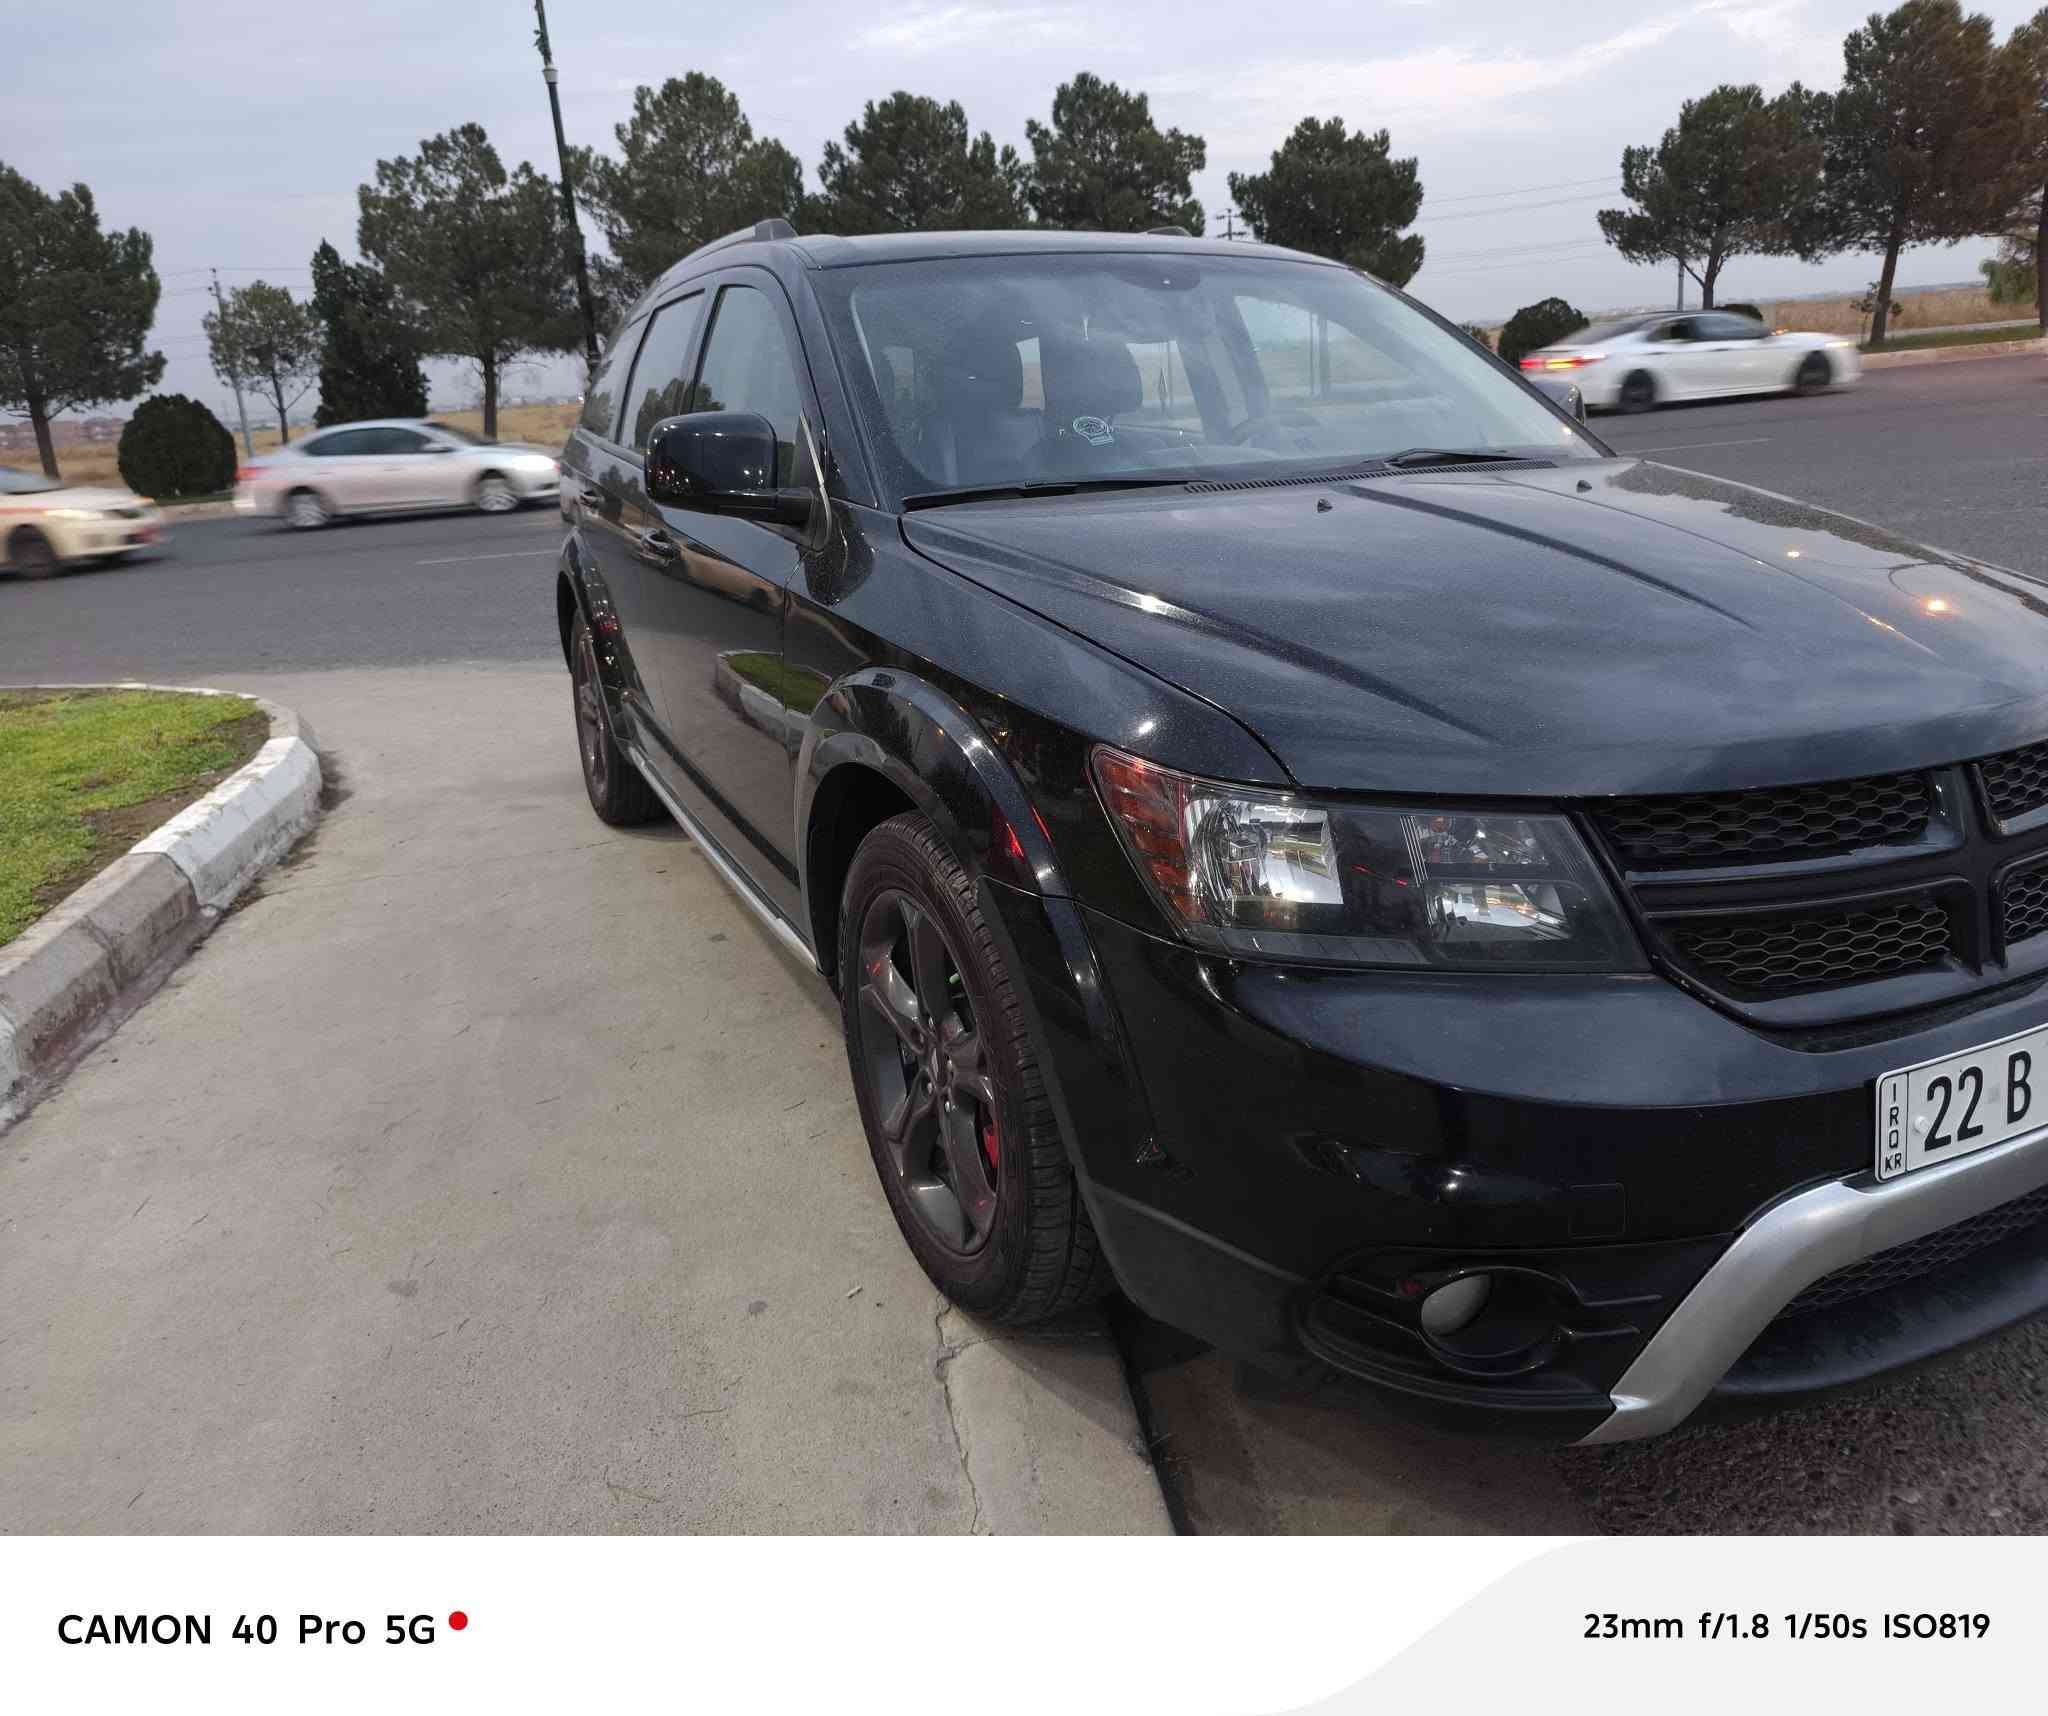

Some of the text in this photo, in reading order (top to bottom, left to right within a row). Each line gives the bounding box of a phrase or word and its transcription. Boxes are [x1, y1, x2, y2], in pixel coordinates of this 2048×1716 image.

[1924, 1050, 2032, 1152] 22 B
[1884, 1153, 1902, 1172] KR
